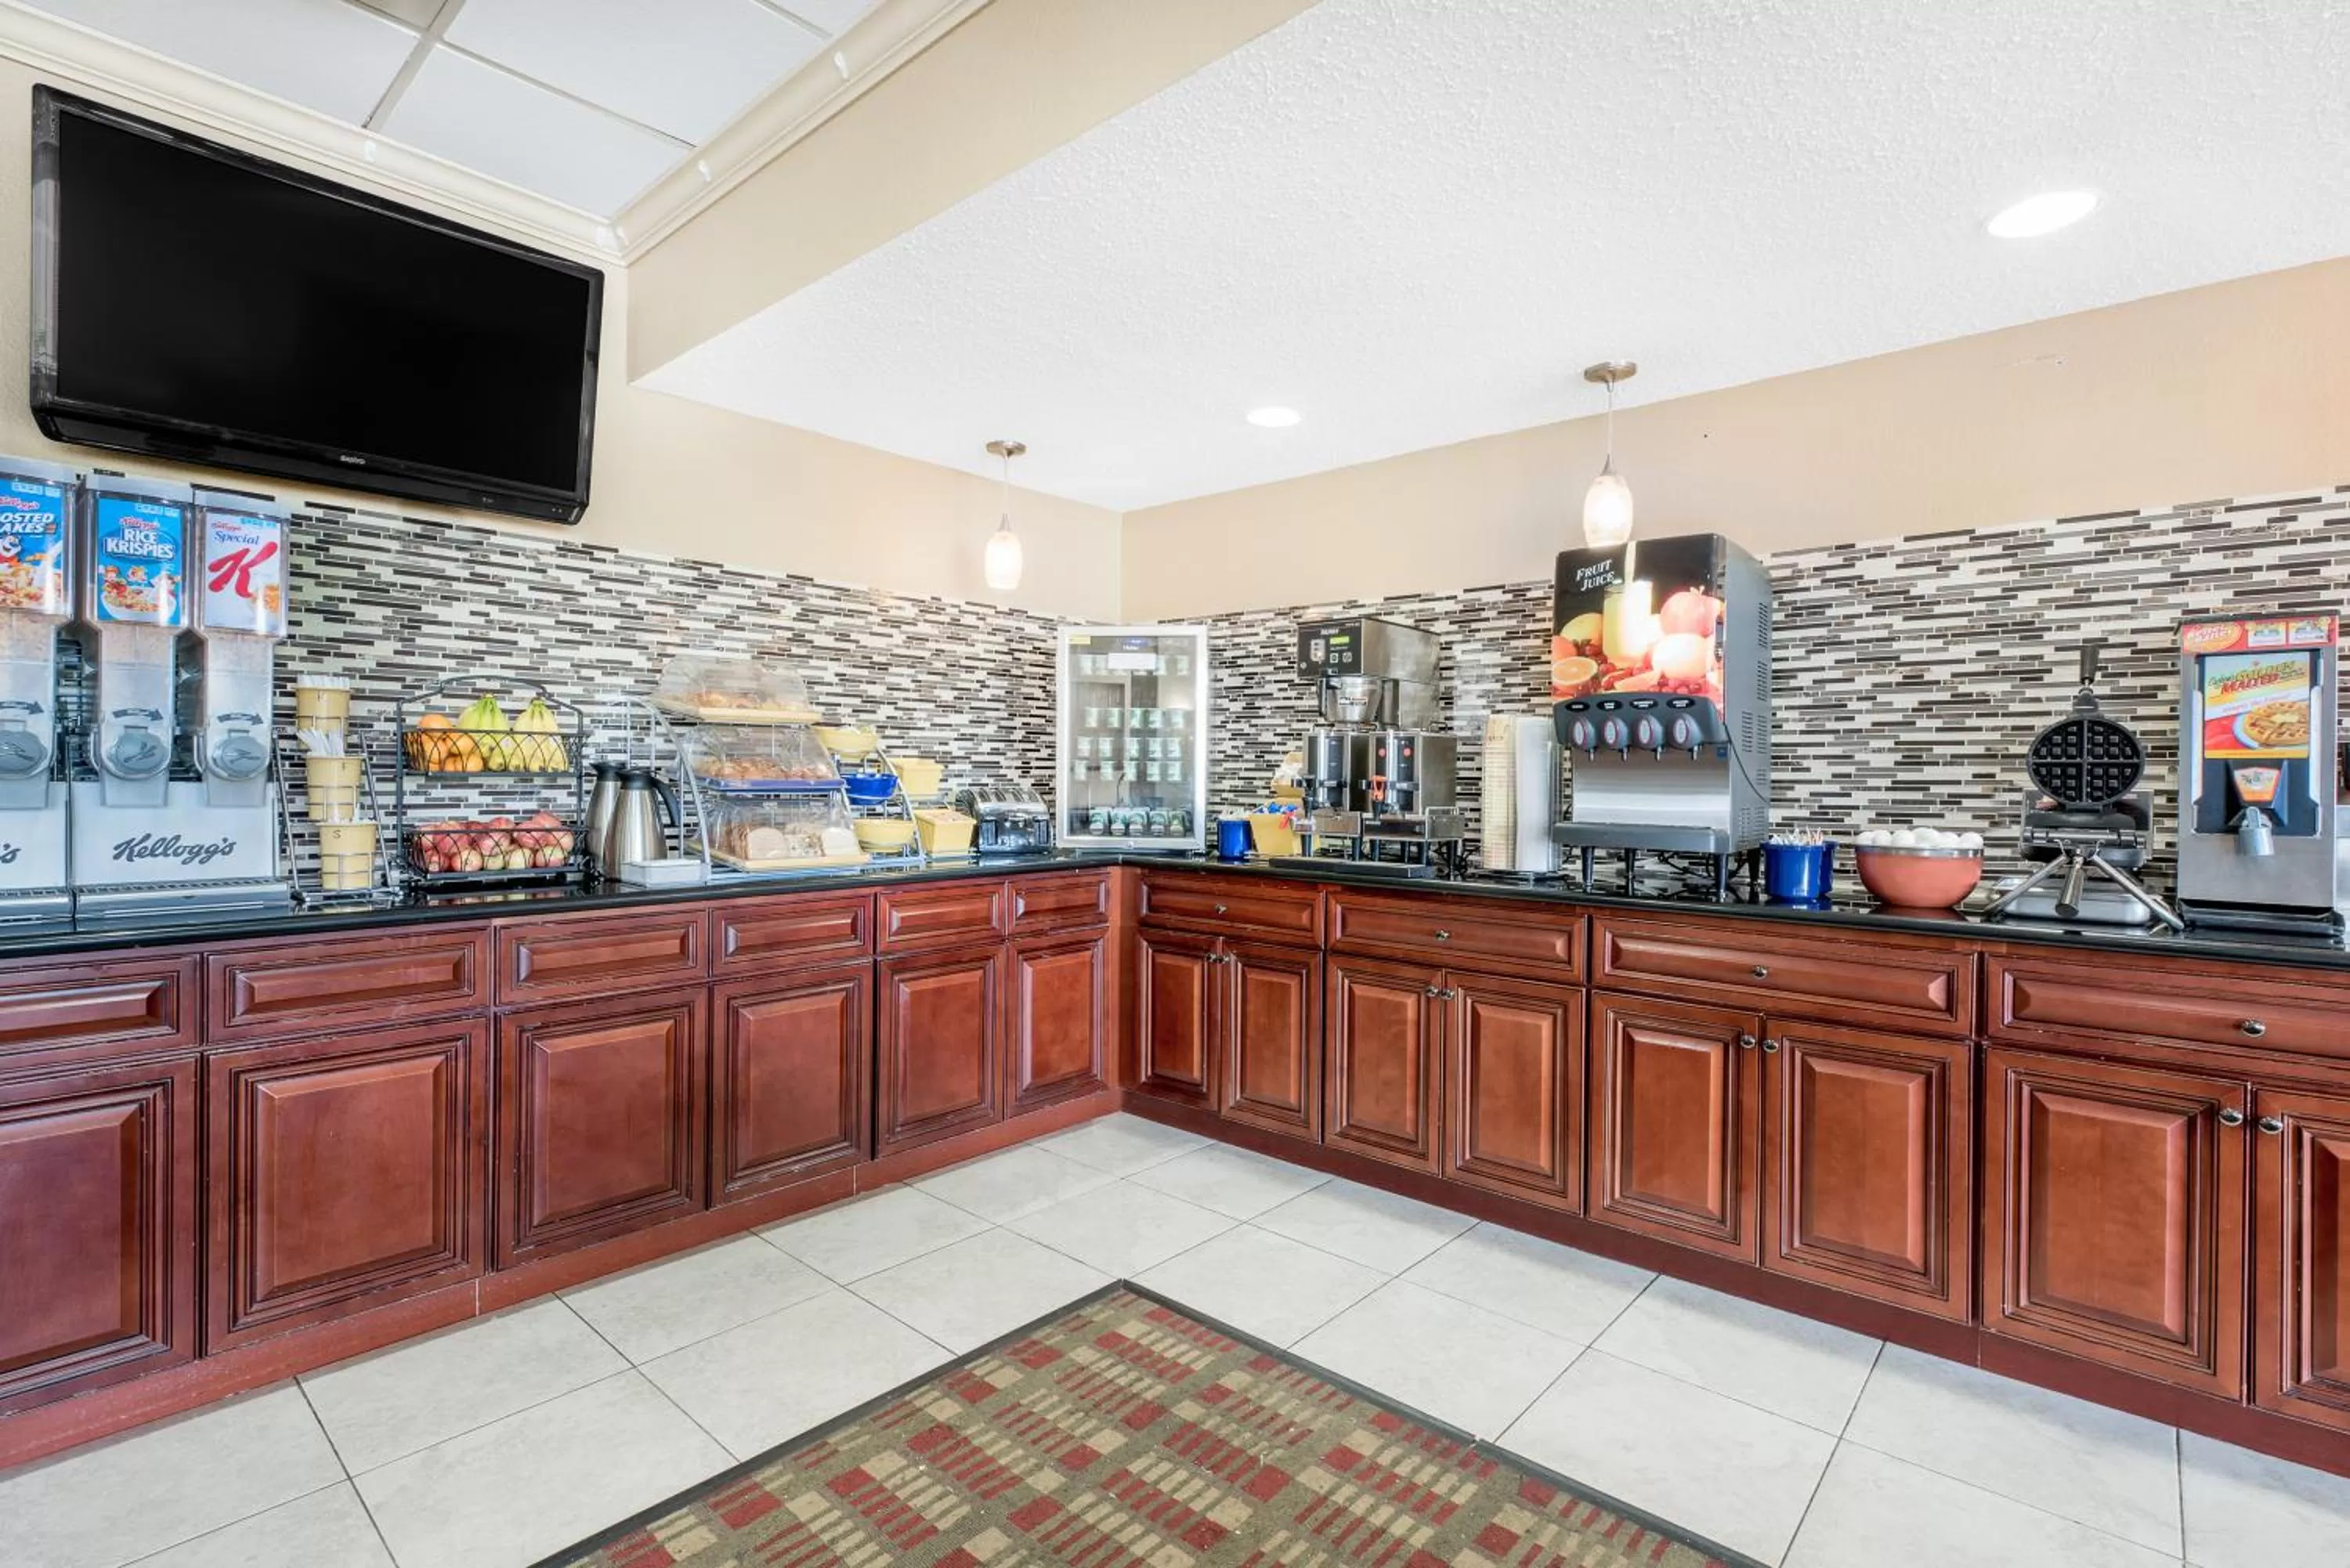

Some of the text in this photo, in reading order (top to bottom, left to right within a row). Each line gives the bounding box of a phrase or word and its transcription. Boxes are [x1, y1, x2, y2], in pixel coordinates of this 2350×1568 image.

[123, 528, 157, 544] RICE
[214, 530, 260, 546] Special
[105, 537, 174, 559] KRISPIES
[208, 541, 278, 599] K
[1575, 558, 1613, 582] FRUIT
[1580, 571, 1614, 592] JUICE
[113, 833, 237, 865] Kellogg's
